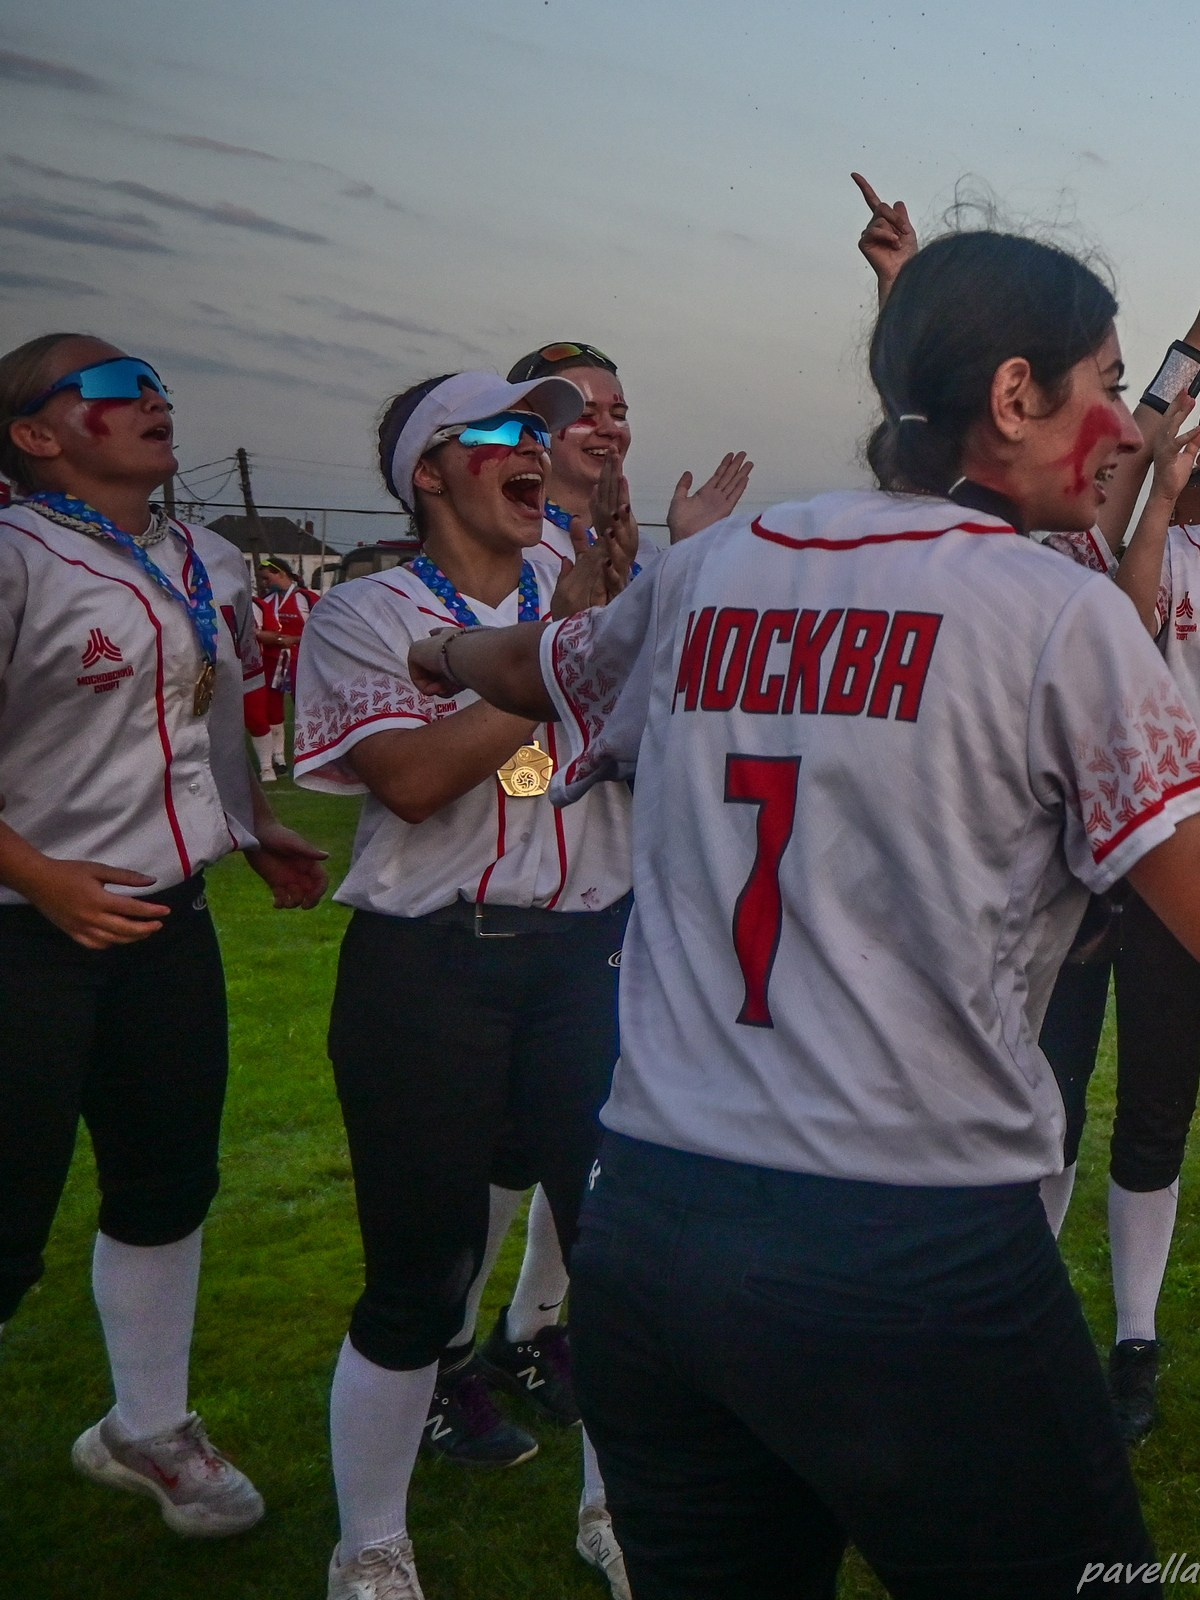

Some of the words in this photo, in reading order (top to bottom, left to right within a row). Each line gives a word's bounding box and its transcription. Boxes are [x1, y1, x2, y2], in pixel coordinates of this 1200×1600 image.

[76, 664, 135, 687] МОСКОВСКИЙ
[94, 680, 120, 694] СПОРТ
[671, 606, 944, 723] МОСКВА
[724, 752, 802, 1029] 7
